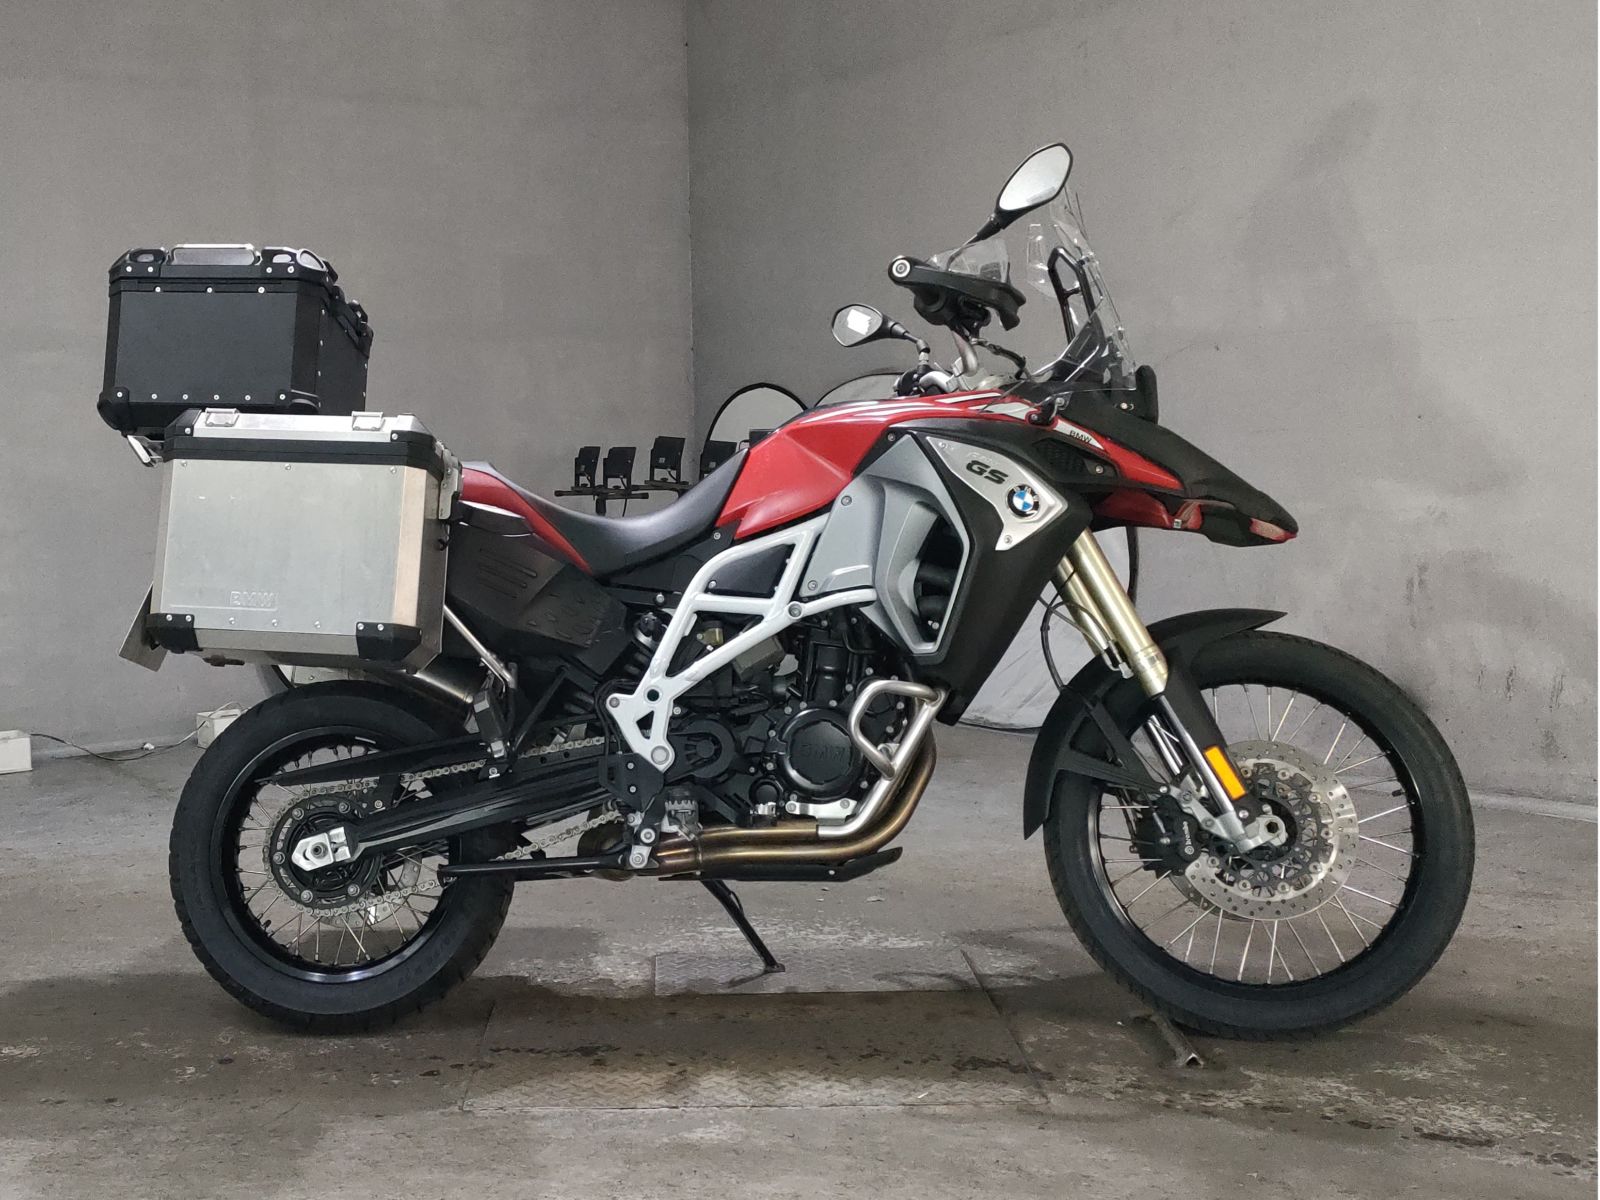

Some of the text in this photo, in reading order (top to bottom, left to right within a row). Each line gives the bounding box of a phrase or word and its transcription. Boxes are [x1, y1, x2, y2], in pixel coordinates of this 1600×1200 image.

[1069, 430, 1092, 444] BMW
[966, 460, 1009, 485] GS
[230, 591, 278, 608] BMW
[800, 743, 848, 760] BMW
